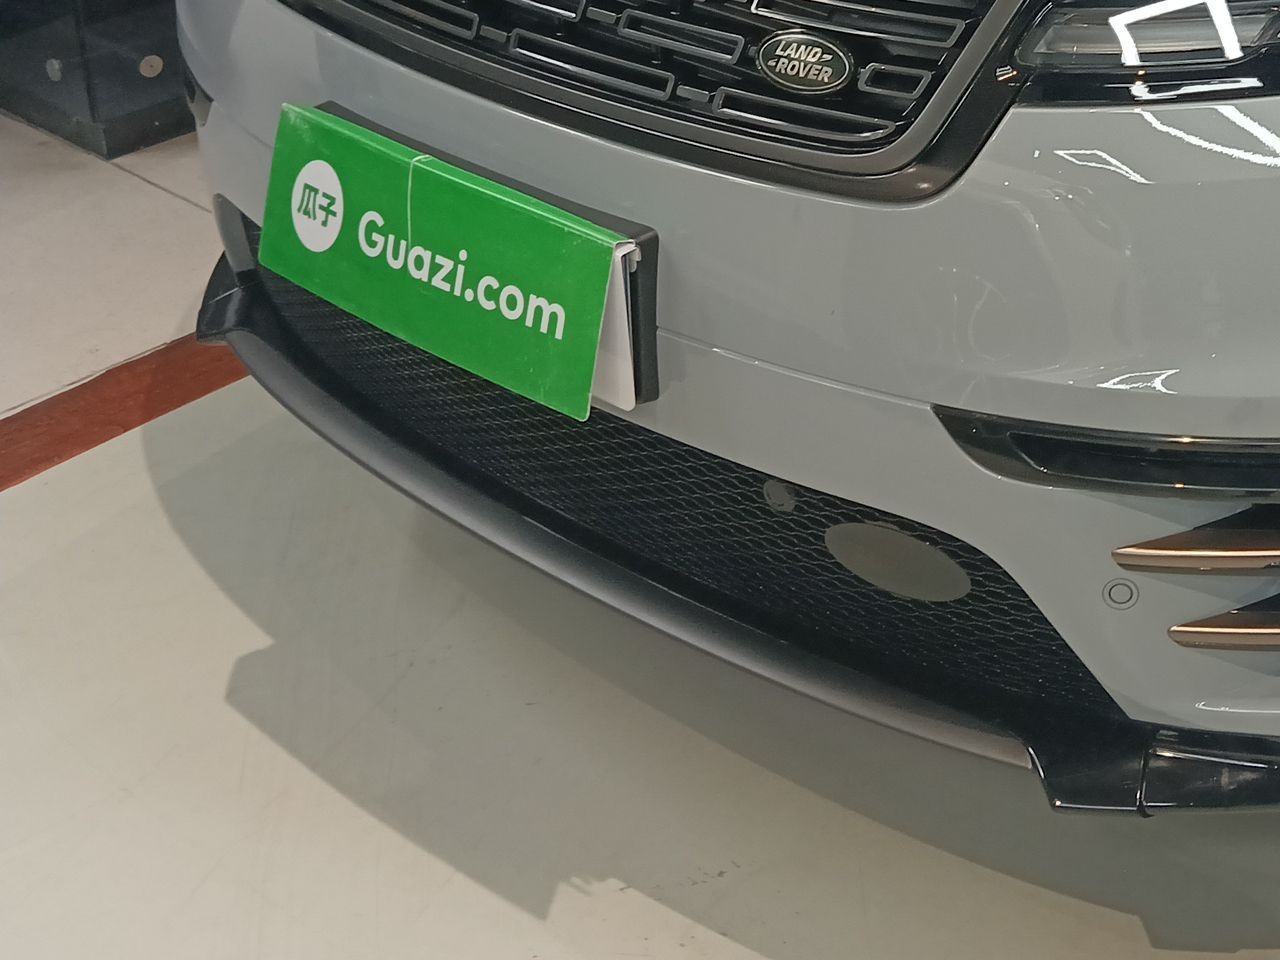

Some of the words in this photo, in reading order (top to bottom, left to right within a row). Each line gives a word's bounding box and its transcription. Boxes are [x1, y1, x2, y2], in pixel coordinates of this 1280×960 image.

[775, 40, 823, 63] LAND
[775, 58, 833, 83] ROVER
[297, 183, 337, 228] 瓜子
[358, 210, 566, 340] Guazi.com
